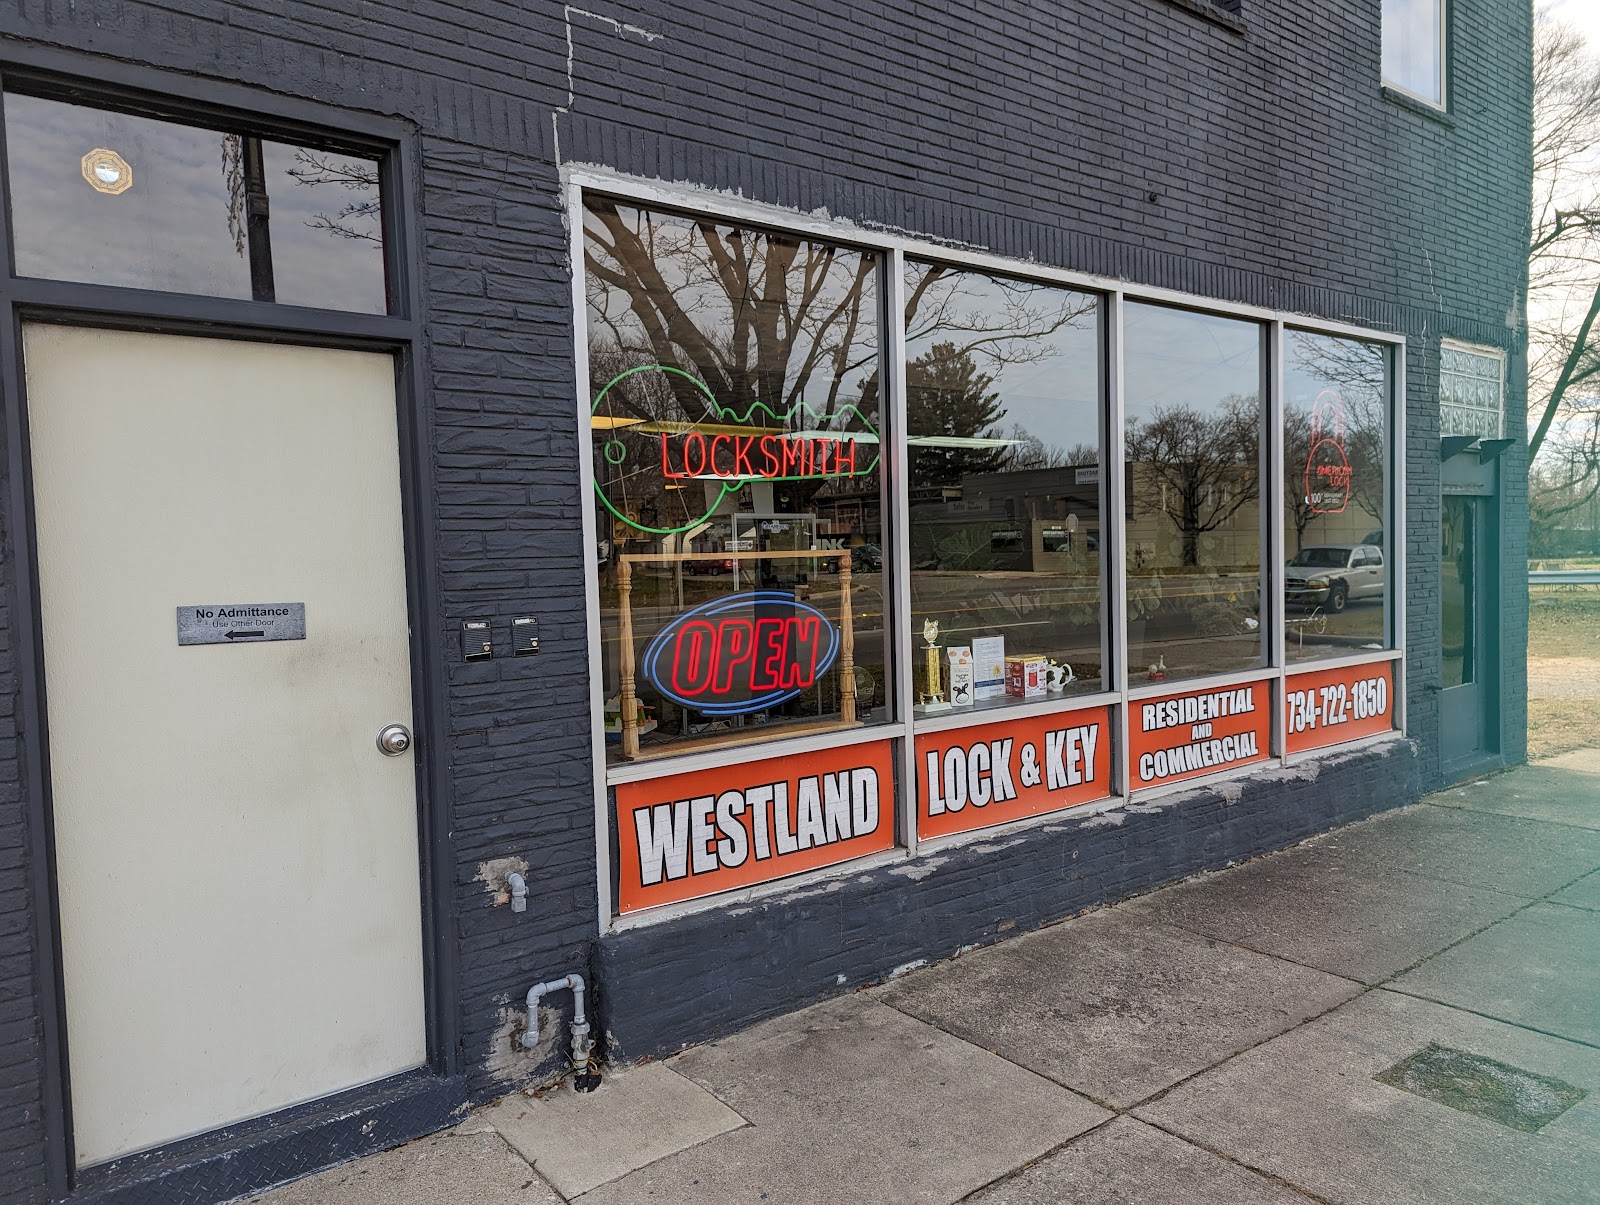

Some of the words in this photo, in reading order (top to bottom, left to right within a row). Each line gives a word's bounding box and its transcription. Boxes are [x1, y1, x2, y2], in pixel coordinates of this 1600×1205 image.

[662, 432, 856, 480] LOCKSMITH
[1317, 465, 1353, 476] AMERICAN
[1330, 475, 1349, 486] LOCK
[196, 609, 214, 619] No
[218, 607, 289, 618] Admittance
[231, 620, 253, 628] Other
[255, 619, 275, 627] Door
[672, 616, 821, 695] OPEN
[1142, 687, 1255, 732] RESIDENTIAL
[1287, 676, 1388, 735] 734-722-1850
[1191, 722, 1213, 742] AND
[926, 737, 1018, 817] LOCK
[1020, 742, 1043, 788] &
[1045, 723, 1099, 792] KEY
[1139, 731, 1259, 782] COMMERCIAL
[633, 765, 881, 888] WESTLAND
